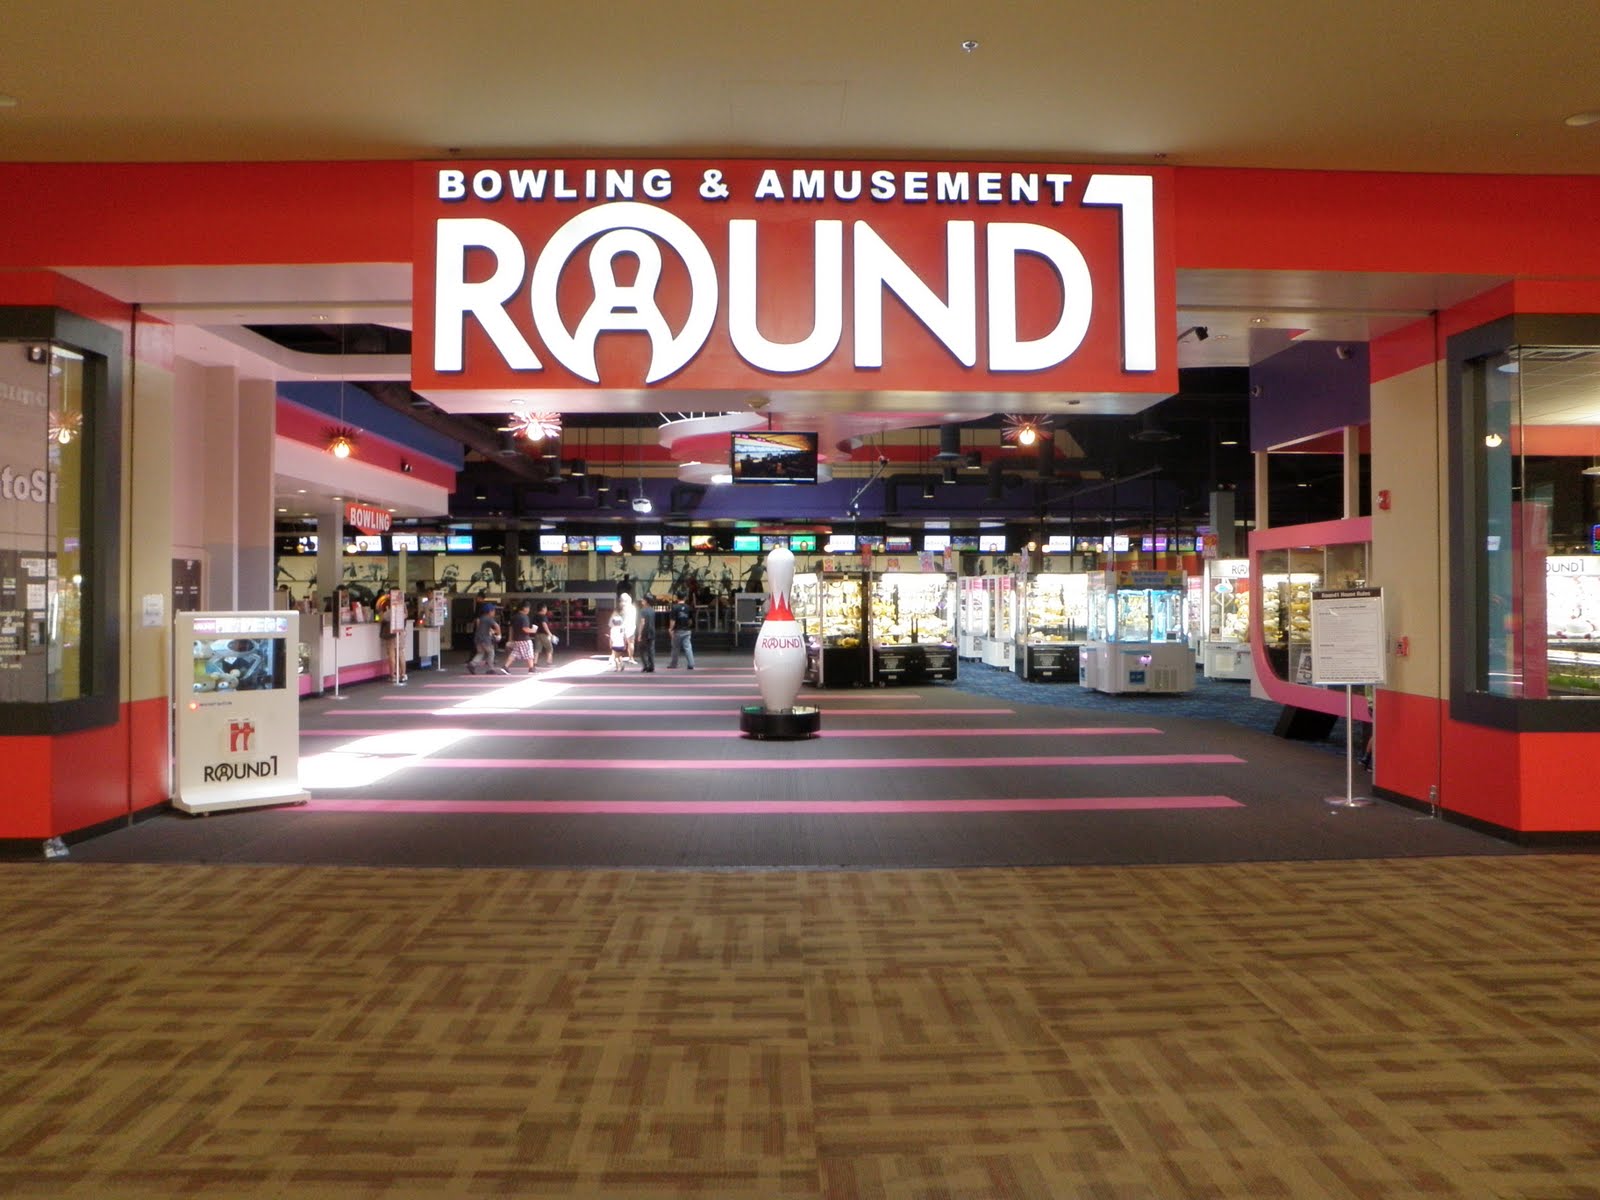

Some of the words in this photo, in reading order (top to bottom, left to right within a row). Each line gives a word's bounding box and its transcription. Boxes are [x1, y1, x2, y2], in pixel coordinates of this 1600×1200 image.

[438, 168, 673, 201] BOWLING
[699, 168, 730, 200] &
[754, 170, 1073, 203] AMUSEMENT
[350, 507, 390, 531] BOWLING
[204, 756, 278, 783] ROUND1
